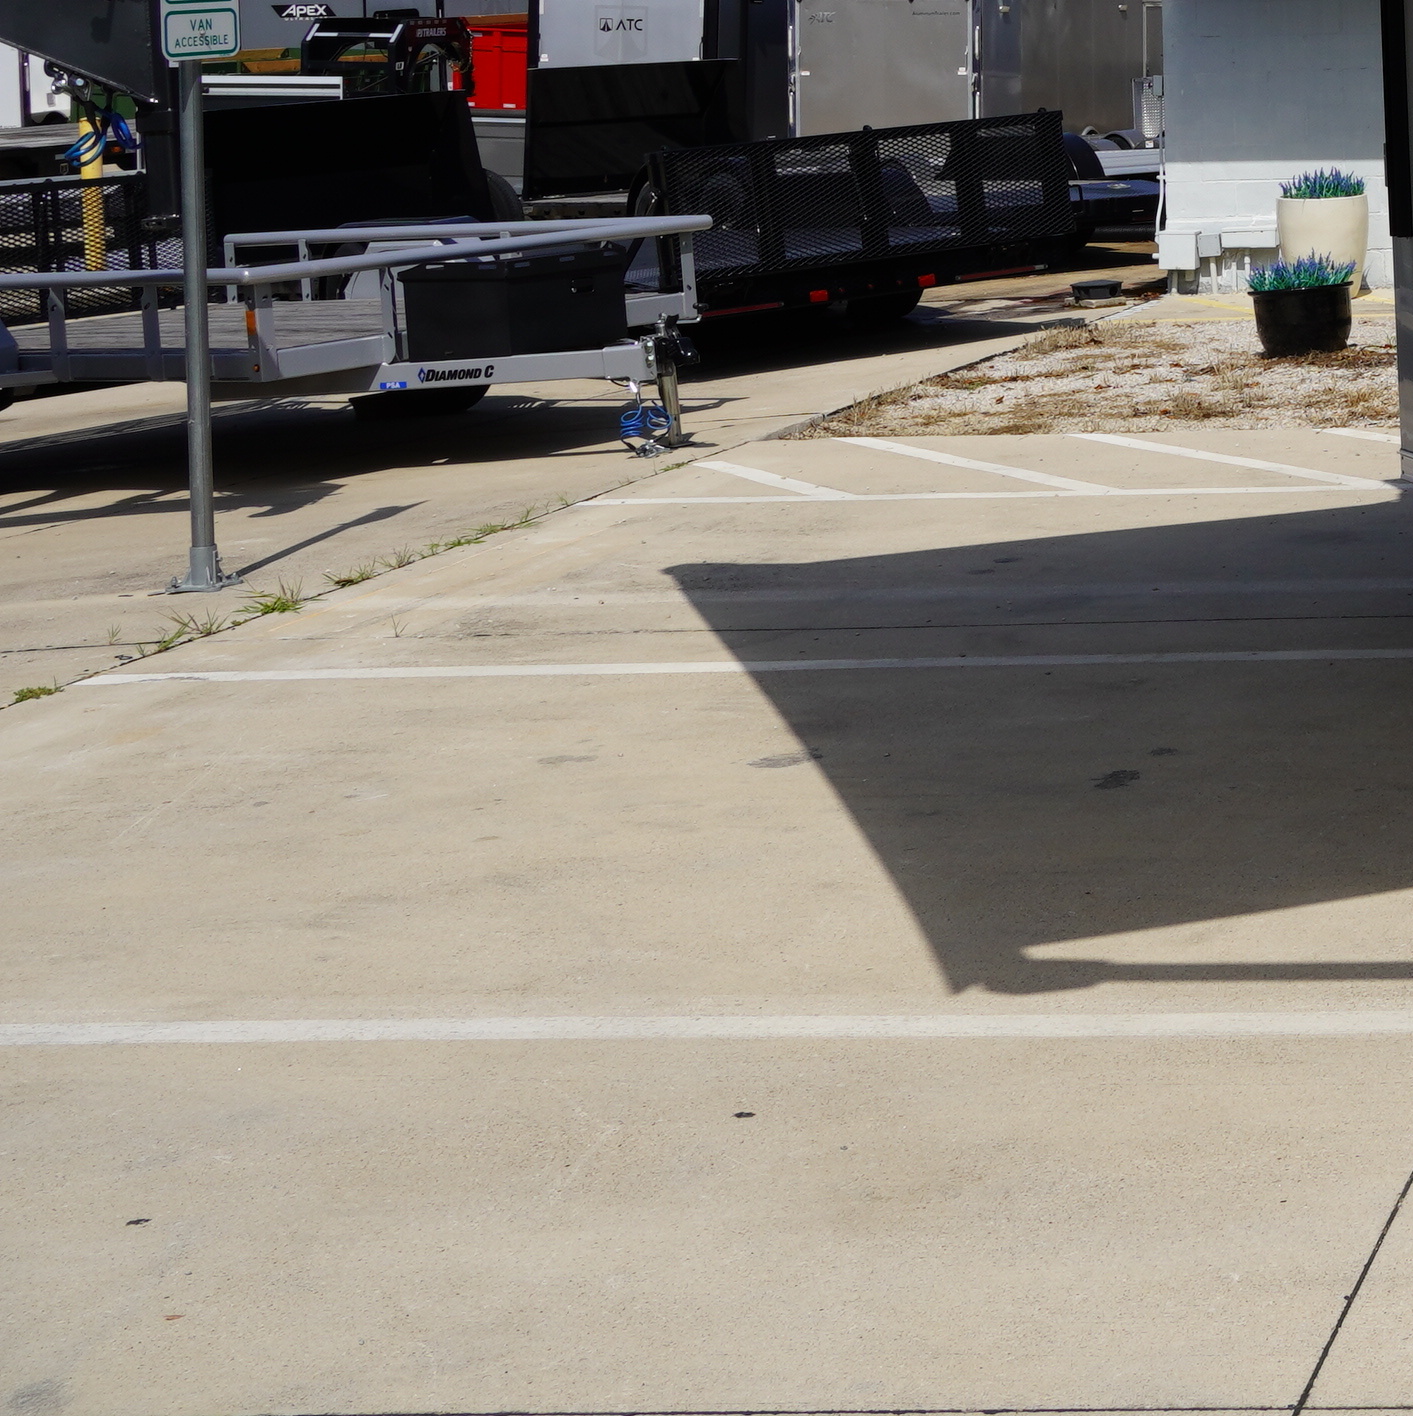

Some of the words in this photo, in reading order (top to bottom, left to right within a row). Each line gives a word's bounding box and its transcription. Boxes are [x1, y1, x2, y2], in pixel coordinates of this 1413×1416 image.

[281, 4, 328, 18] APEX
[190, 18, 213, 32] VAN
[615, 18, 643, 31] ATC
[174, 34, 229, 49] ACCESSIBLE
[484, 365, 495, 379] C
